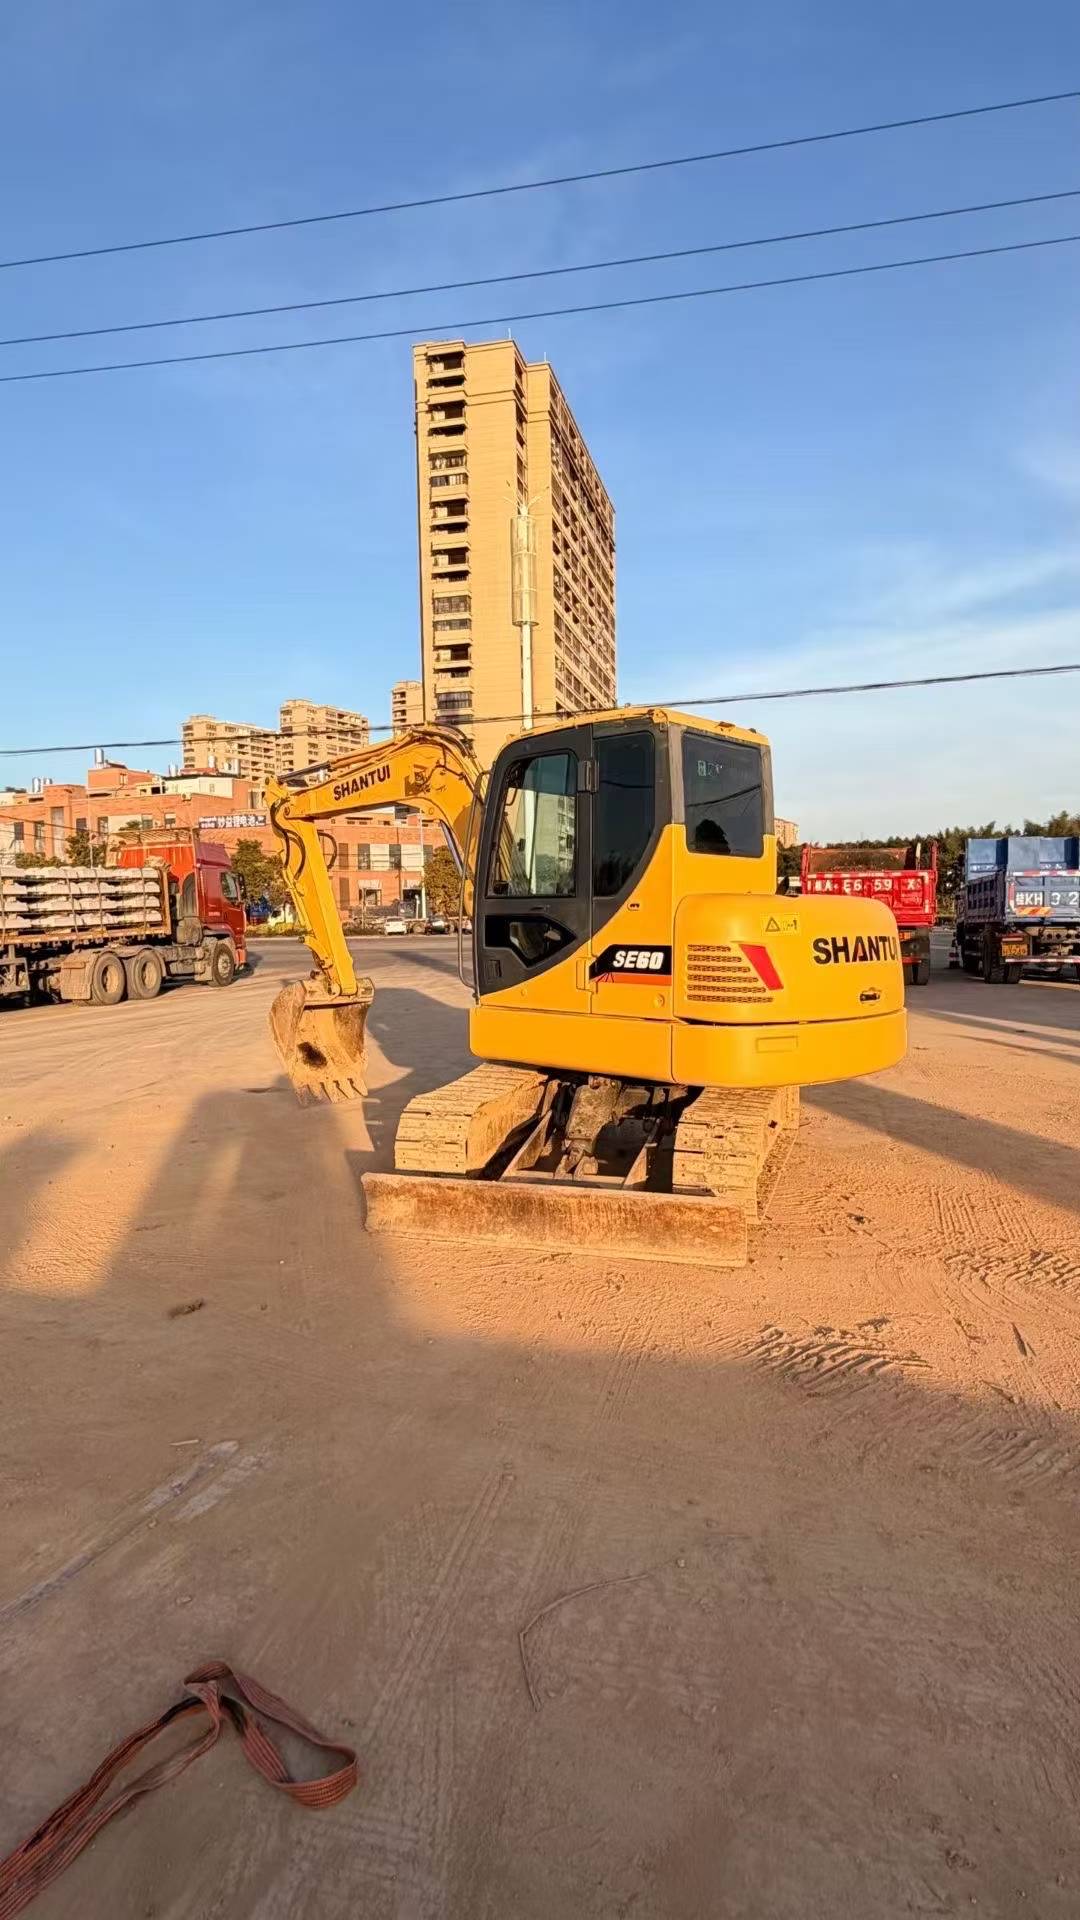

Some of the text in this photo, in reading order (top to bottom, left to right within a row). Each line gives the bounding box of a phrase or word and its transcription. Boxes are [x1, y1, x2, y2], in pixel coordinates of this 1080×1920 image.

[333, 764, 391, 801] SHANTUI
[613, 950, 664, 970] SE60
[812, 935, 898, 964] SHANTU
